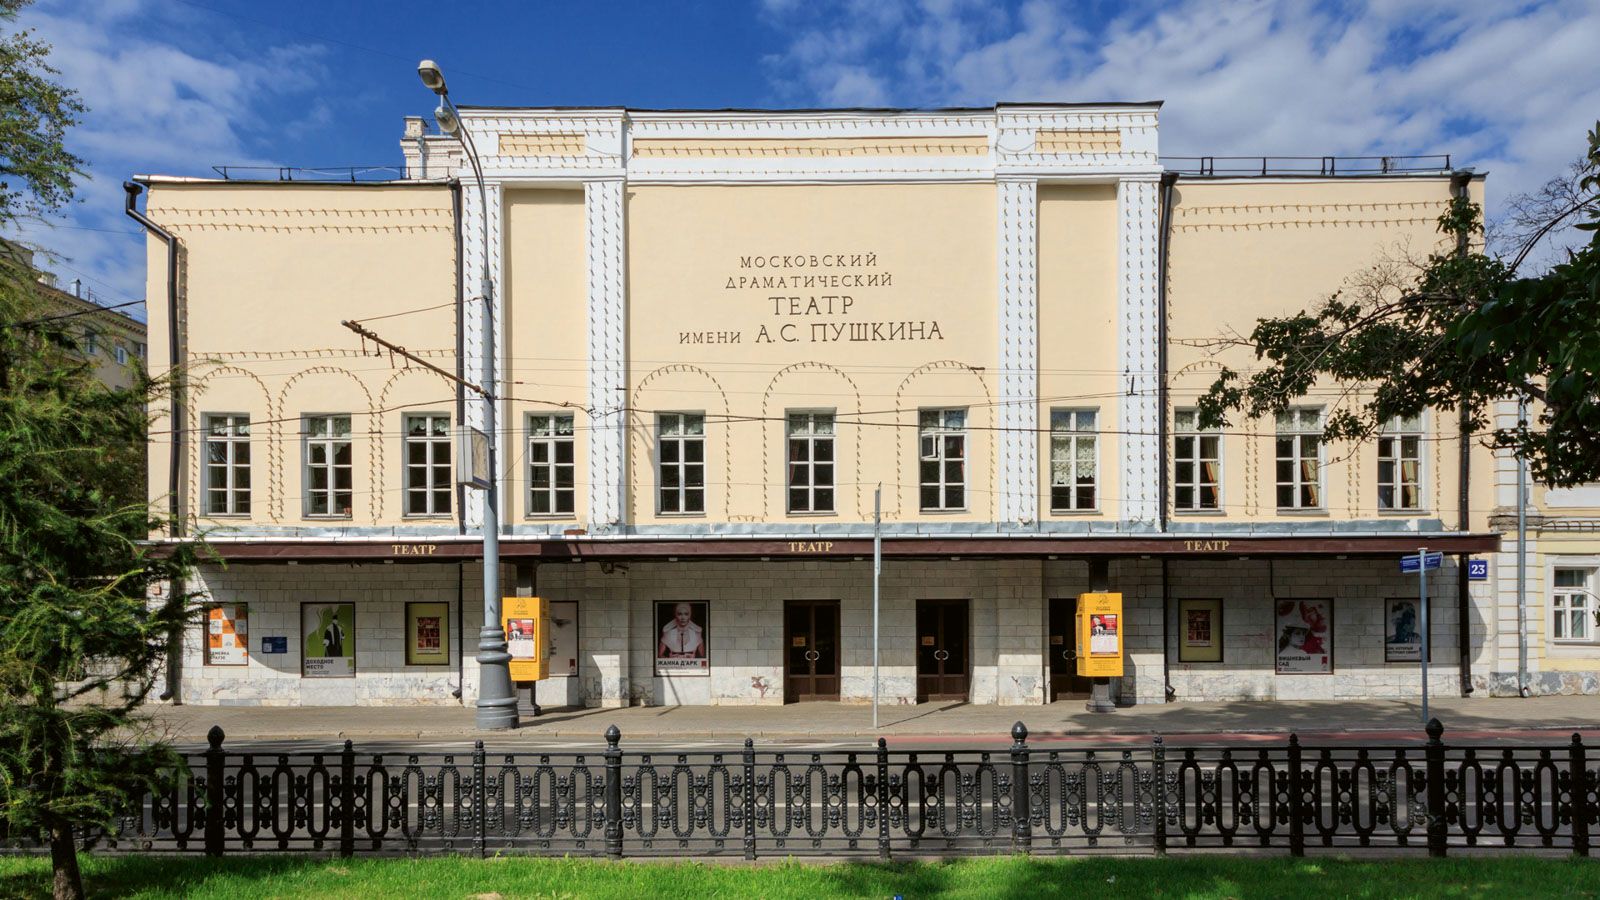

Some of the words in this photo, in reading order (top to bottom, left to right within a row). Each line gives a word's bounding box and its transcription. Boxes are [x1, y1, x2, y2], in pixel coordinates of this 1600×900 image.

[740, 252, 877, 268] МОСКОВСКИЙ
[725, 272, 892, 289] ДРАМАТИЧЕСКИЙ
[768, 296, 854, 315] ТЕАТР
[679, 331, 741, 344] ИМЕНИ
[811, 321, 944, 342] ПУШКИНА
[392, 544, 436, 555] ТЕАТР
[788, 541, 833, 552] ТЕАТР
[1184, 540, 1230, 551] ТЕАТР
[1471, 564, 1485, 575] 23
